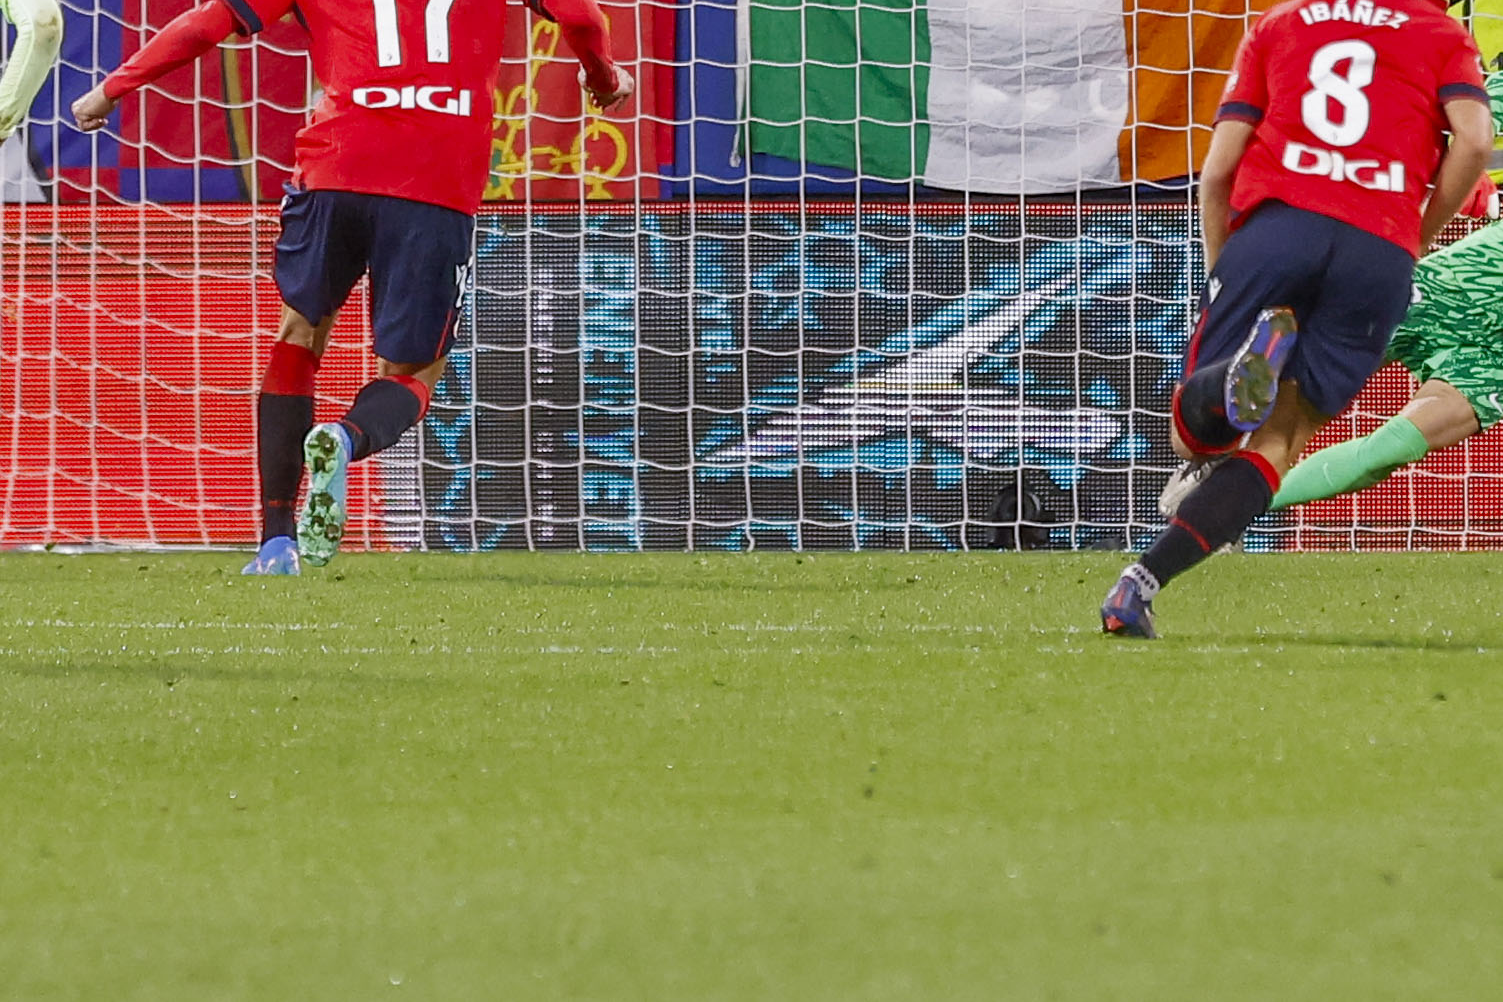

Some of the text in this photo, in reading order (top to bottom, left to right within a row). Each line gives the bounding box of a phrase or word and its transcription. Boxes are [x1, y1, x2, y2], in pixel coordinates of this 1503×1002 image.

[352, 85, 471, 116] DIGI
[1301, 38, 1377, 147] 8
[1281, 140, 1406, 193] DIGI
